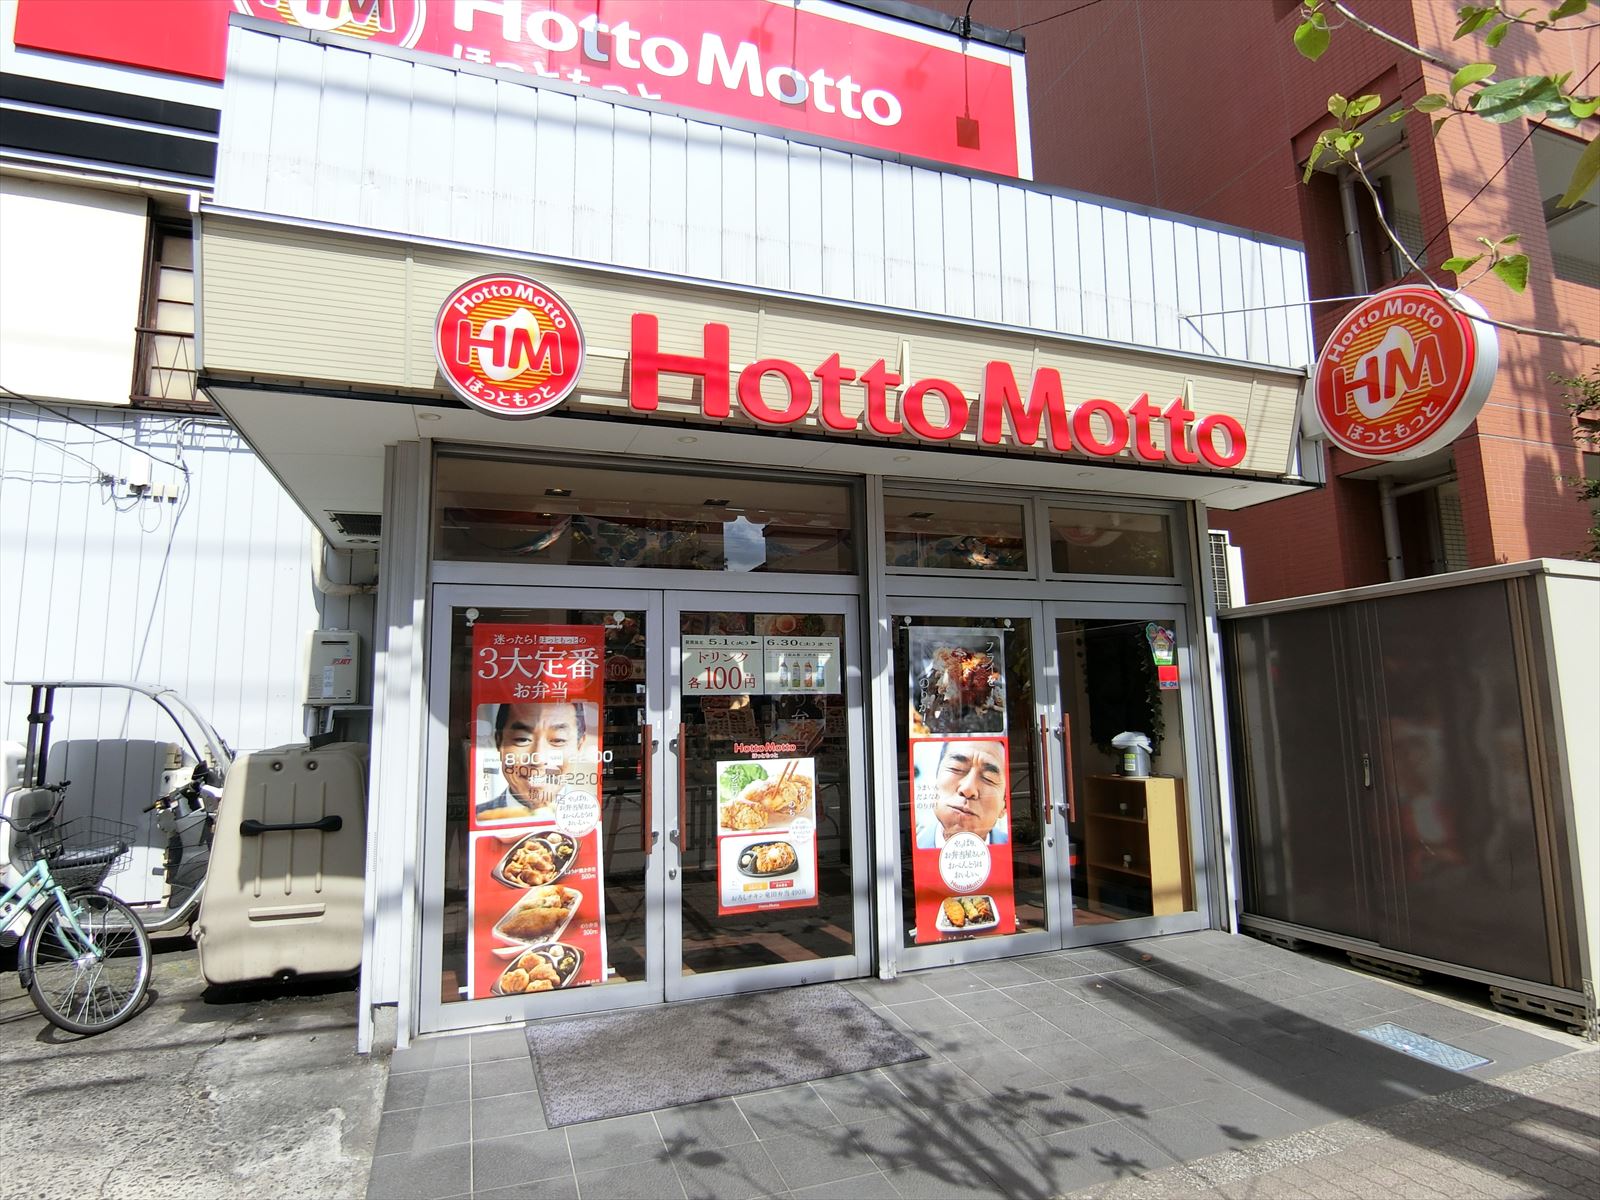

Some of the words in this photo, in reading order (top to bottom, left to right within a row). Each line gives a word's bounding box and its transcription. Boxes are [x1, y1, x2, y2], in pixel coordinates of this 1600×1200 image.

[456, 319, 563, 376] HM
[1332, 333, 1446, 416] HM
[464, 376, 556, 408] ほっともっと
[1346, 402, 1440, 444] ほっともっと
[478, 647, 599, 680] 3大定番
[698, 651, 749, 664] ドリンク
[513, 681, 568, 699] お弁当
